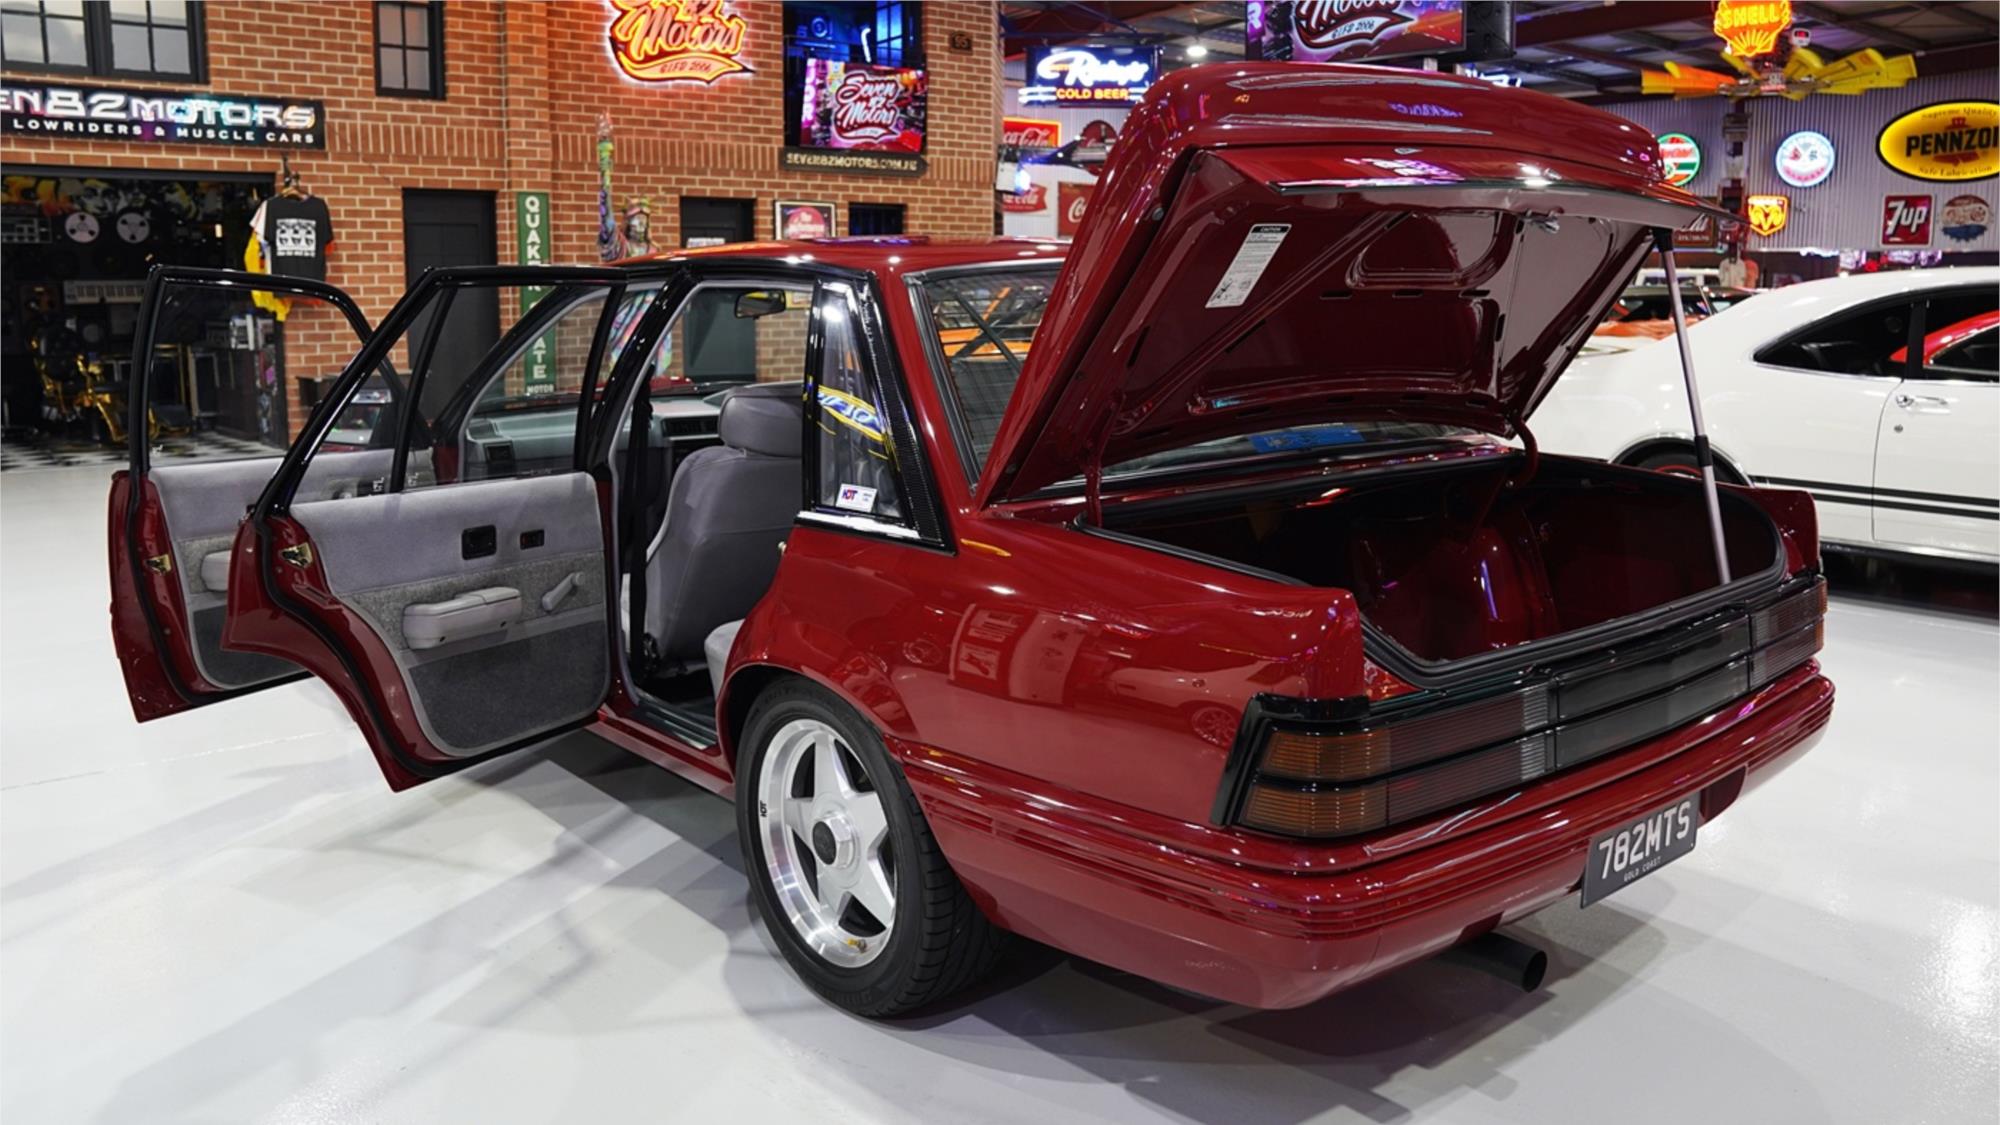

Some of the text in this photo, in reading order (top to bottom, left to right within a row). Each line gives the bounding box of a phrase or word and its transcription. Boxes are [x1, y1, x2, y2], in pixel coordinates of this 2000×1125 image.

[1720, 4, 1780, 28] SHELL
[618, 5, 742, 59] Motors
[838, 76, 896, 103] Seven
[1056, 88, 1128, 100] COLD BEER
[836, 101, 895, 128] Motors
[13, 118, 314, 144] LOWRIDERS & MUSCLE CARS
[1886, 200, 1929, 235] 7up
[524, 195, 542, 291] QUAK
[527, 384, 554, 393] MOTOR
[1598, 801, 1691, 879] 782MTS
